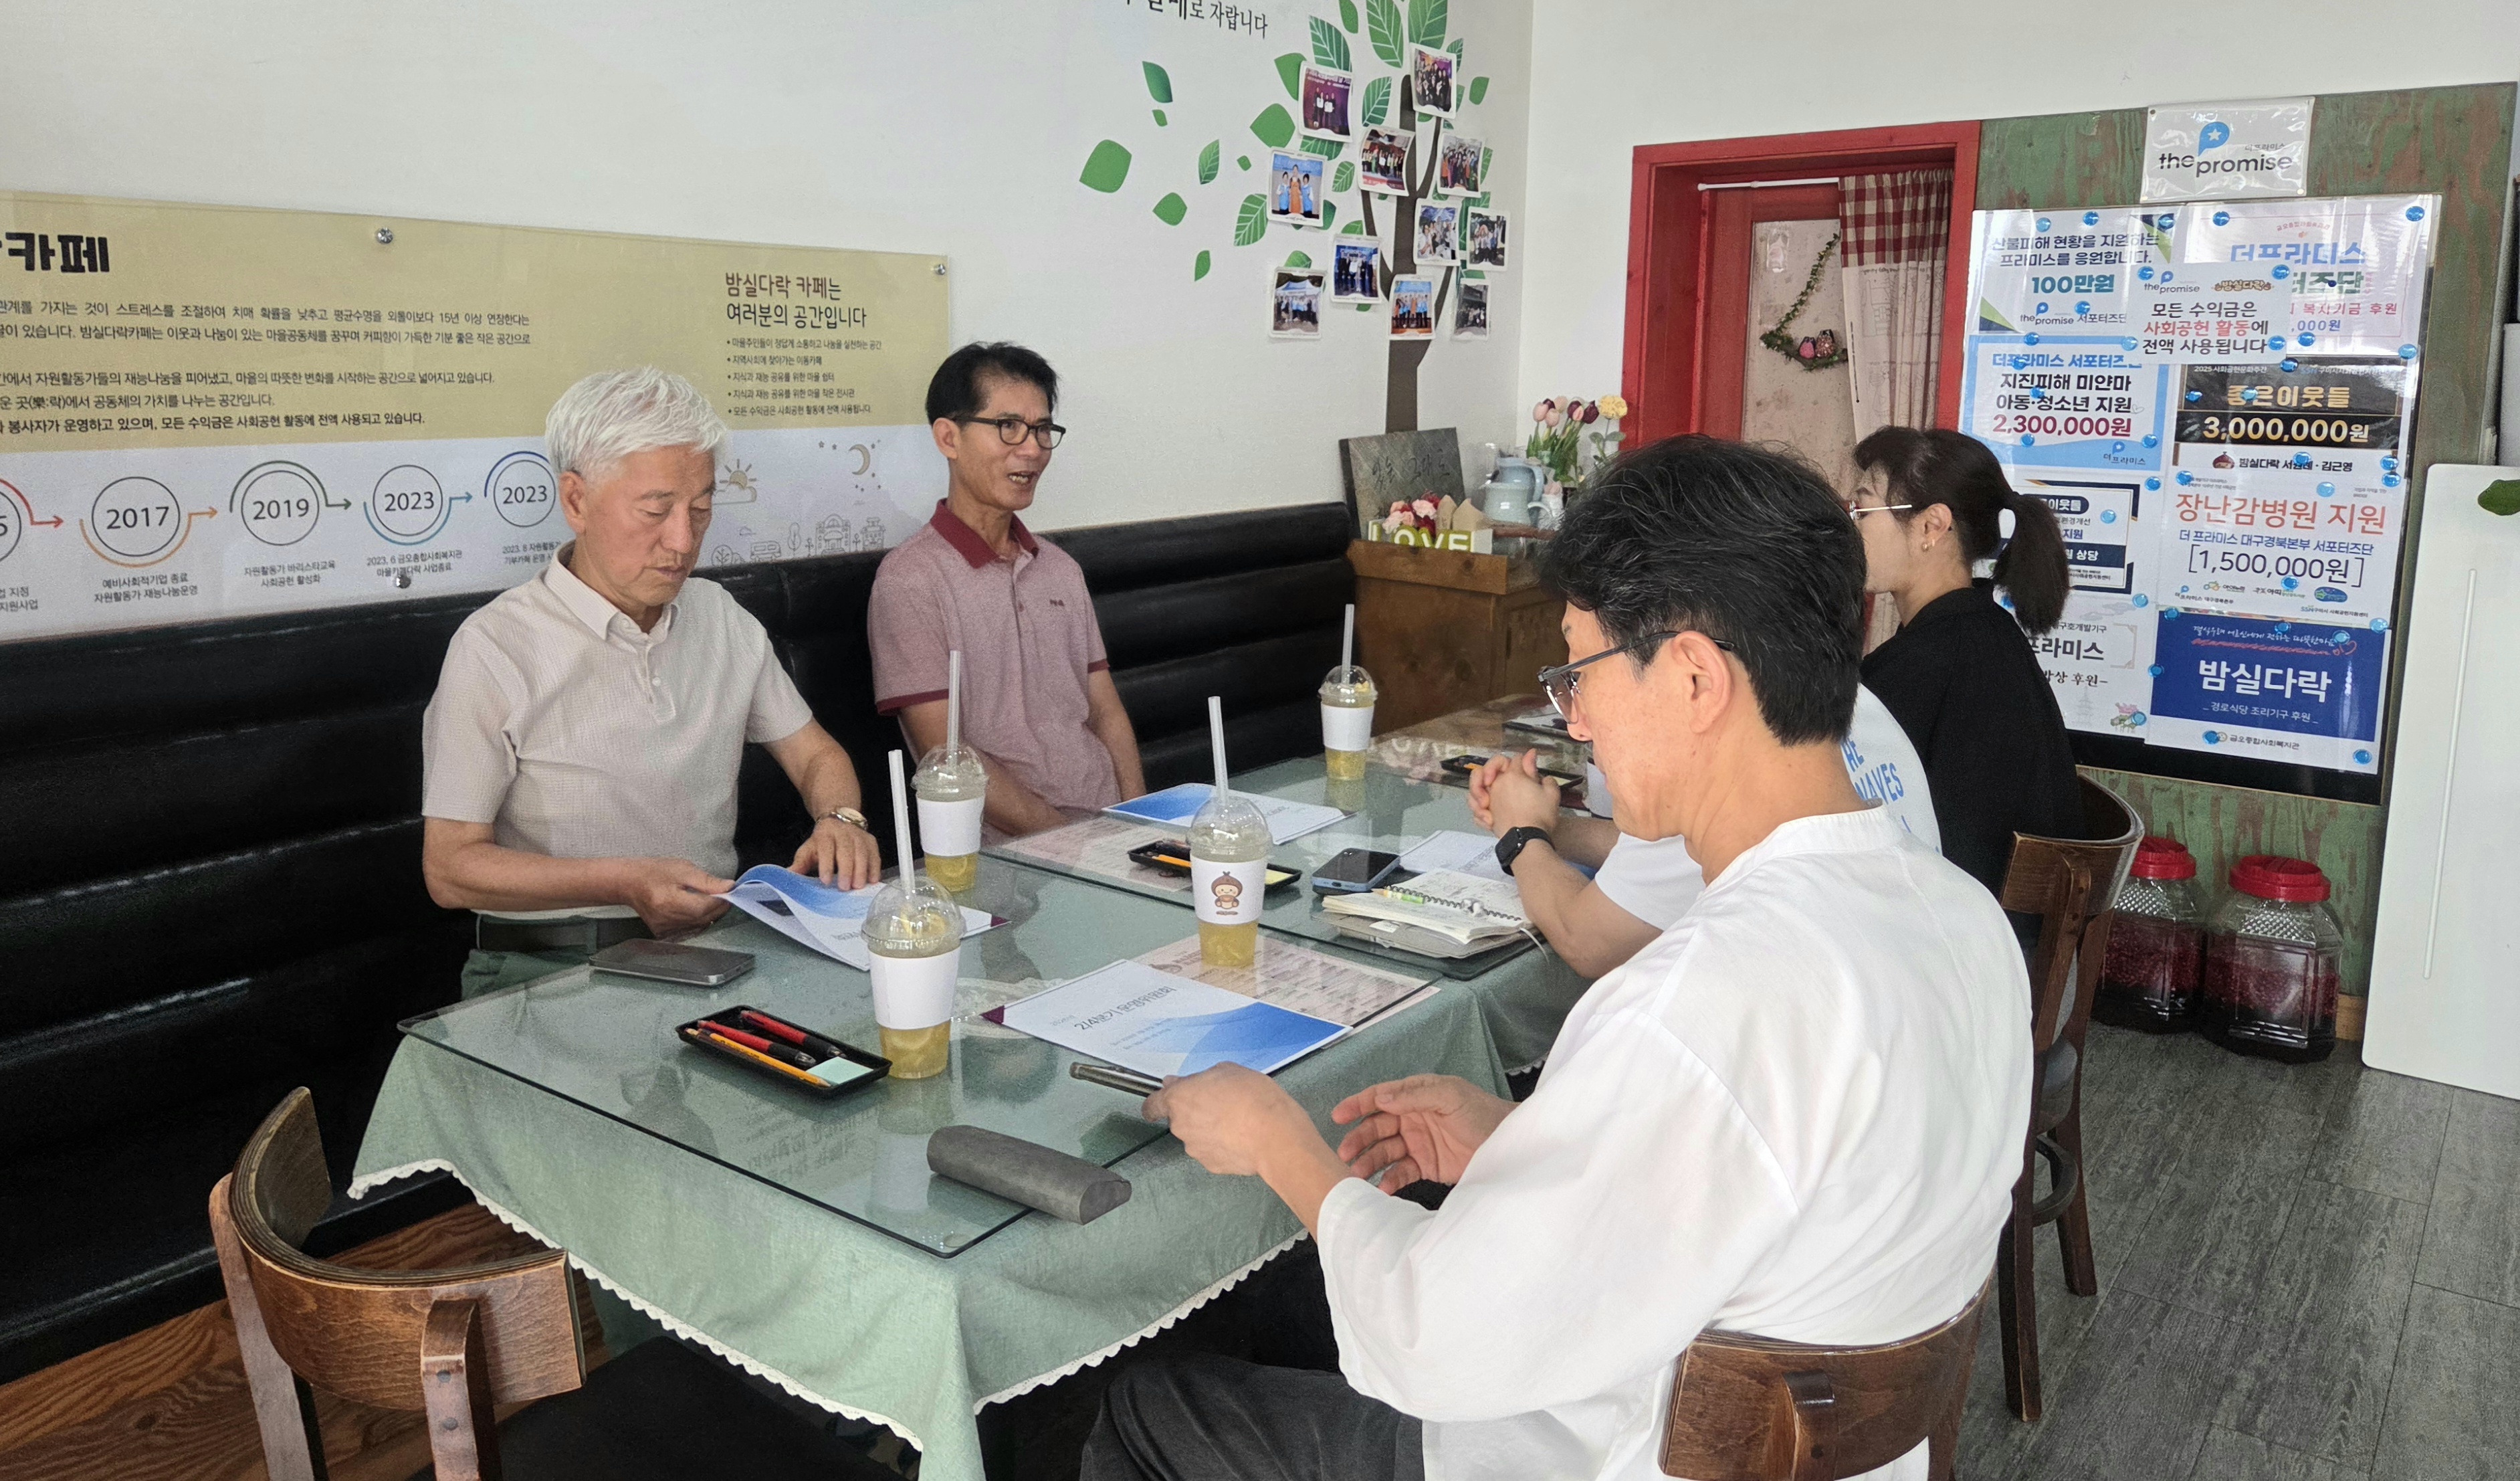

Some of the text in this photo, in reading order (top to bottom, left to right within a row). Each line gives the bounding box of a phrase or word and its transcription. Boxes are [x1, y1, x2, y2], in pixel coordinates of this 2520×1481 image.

[1210, 1, 1268, 39] 자랍니다
[2159, 153, 2293, 177] the promise
[5, 231, 110, 273] 카페
[1992, 237, 2050, 251] 산불피해
[2054, 235, 2097, 249] 현황을
[2000, 252, 2071, 267] 프라미스를
[726, 272, 841, 300] 밤실다락 카페는
[2032, 274, 2115, 294] 100만원
[2144, 282, 2200, 294] the promise
[40, 301, 78, 315] 가지는
[85, 303, 109, 316] 것이
[116, 304, 175, 318] 스트레스를
[181, 306, 226, 319] 조절하여
[232, 306, 253, 319] 치매
[260, 307, 291, 321] 확률을
[297, 308, 328, 321] 낮추고
[334, 309, 382, 322] 평균수명을
[439, 312, 459, 324] 15년
[464, 312, 482, 325] 이상
[486, 313, 530, 326] 연장한다는
[727, 302, 867, 329] 여러분의 공간입니다
[2151, 302, 2258, 318] 모든 수익금은
[2369, 302, 2398, 315] 후원
[2020, 314, 2074, 325] the promise
[2143, 319, 2269, 337] 사회공헌 활동에
[22, 324, 531, 345] 있습니다. 밤실다락카페는 이웃과 나눔이 있는 마을공동체를 꿈꾸며 커피향이 가득한 기분 좋은 작은 공간으로
[869, 340, 882, 350] 공간
[2142, 338, 2268, 355] 전액 사용됩니다
[35, 372, 496, 387] 자원활동가들의 재능나눔을 피어냈고, 마을의 따뜻한 변화를 시작하는 공간으로 넓어지고 있습니다.
[755, 373, 769, 382] 재능
[793, 373, 806, 382] 위한
[807, 373, 821, 382] 마을
[2000, 373, 2131, 391] 지진피해 미얀마
[93, 394, 141, 409] 공동체의
[144, 393, 178, 408] 가치를
[182, 393, 215, 407] 나누는
[218, 394, 276, 407] 공간입니다.
[756, 389, 769, 399] 재능
[793, 389, 806, 399] 위한
[807, 389, 821, 398] 마을
[2095, 396, 2132, 413] 지원
[8, 419, 60, 435] 봉사자가
[64, 417, 112, 433] 운영하고
[117, 417, 157, 432] 있으며,
[161, 416, 185, 429] 모든
[188, 415, 233, 429] 수익금은
[236, 415, 280, 429] 사회공헌
[284, 413, 315, 427] 활동에
[318, 413, 338, 426] 전액
[341, 413, 381, 425] 사용되고
[383, 412, 425, 425] 있습니다.
[1993, 414, 2132, 437] 2,300,000원
[2203, 416, 2370, 443] 3,000,000원
[2103, 453, 2146, 466] 더프라미스
[2239, 458, 2353, 472] 밤실다락 김근영
[384, 491, 435, 512] 2023
[503, 486, 548, 504] 2023
[106, 506, 170, 530] 2017
[252, 498, 310, 521] 2019
[2176, 493, 2387, 535] 장난감병원 지원
[2062, 528, 2083, 540] 지원
[2179, 530, 2374, 557] 더 프라미스 대구경북본부 서포터즈단
[2076, 549, 2099, 561] 상당
[102, 574, 169, 589] 예비사회적기업
[94, 591, 141, 603] 자원활동가
[2198, 660, 2332, 703] 밤실다락
[2210, 702, 2311, 722] 경로식당 조리기구 후원
[2229, 734, 2300, 751] 금오종합사회복지관
